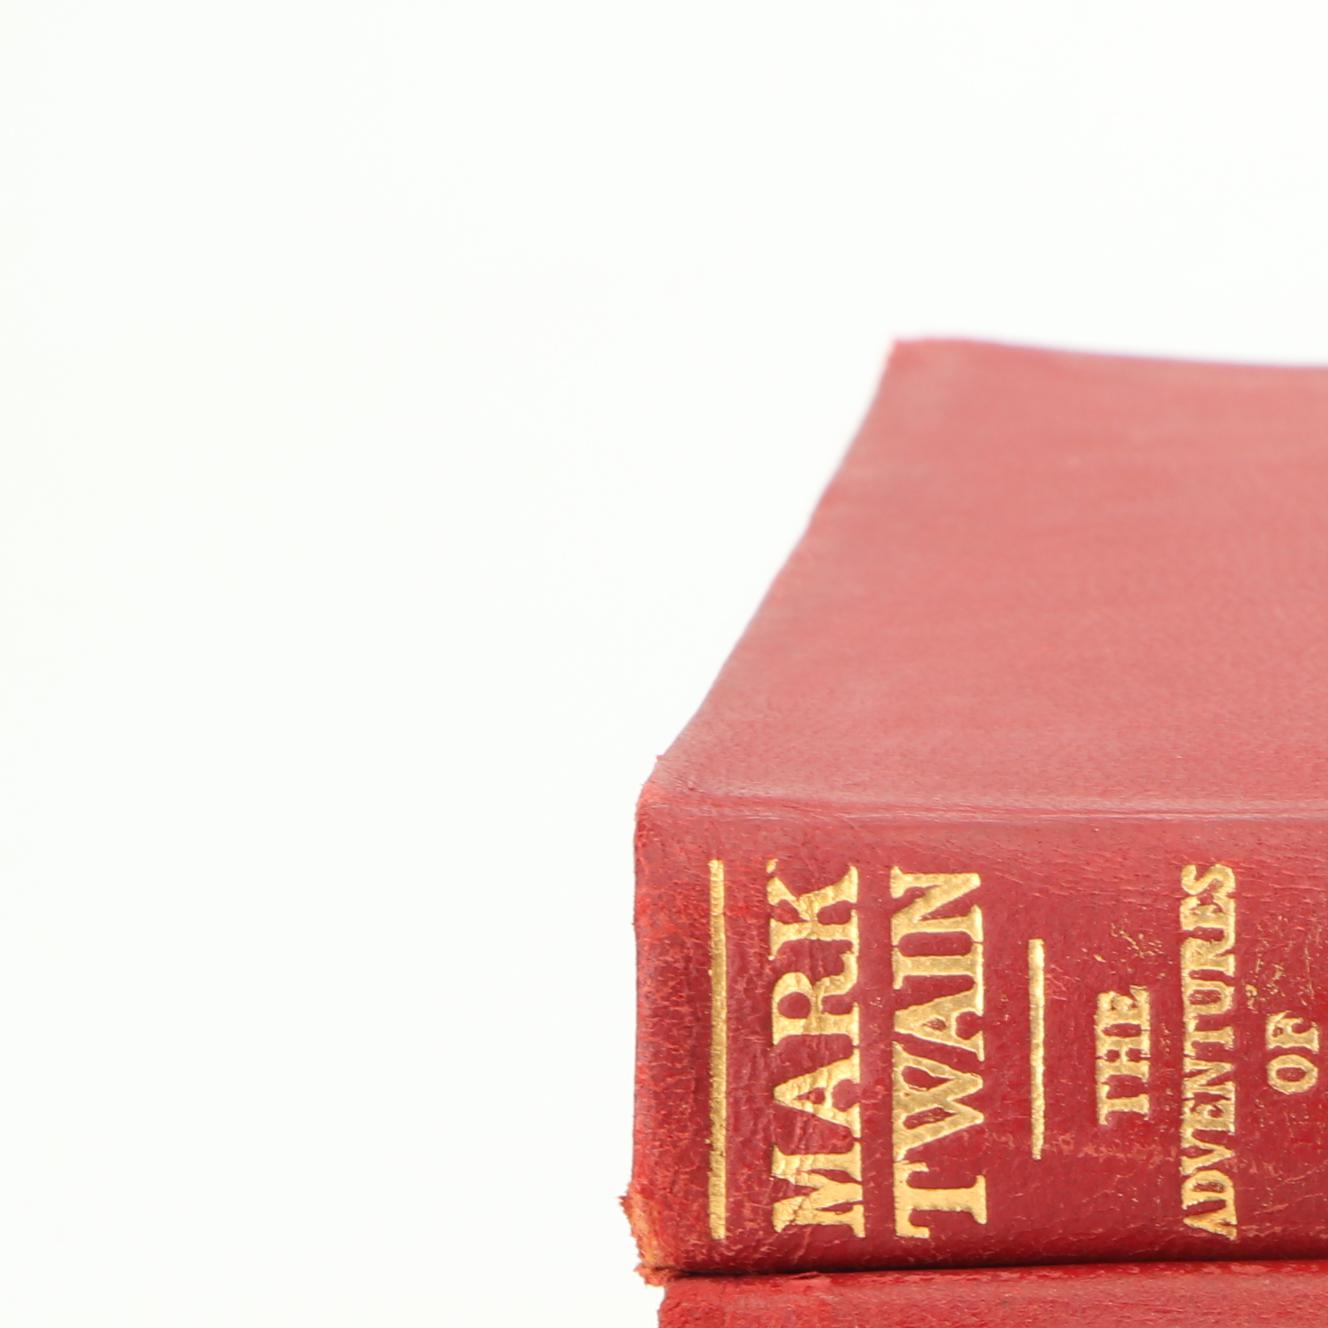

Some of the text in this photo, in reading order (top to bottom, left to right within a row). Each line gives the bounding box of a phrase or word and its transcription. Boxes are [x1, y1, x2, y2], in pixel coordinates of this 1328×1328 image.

[767, 859, 866, 1238] MARK
[891, 865, 987, 1239] TWAIN
[1094, 986, 1151, 1125] THE
[1181, 864, 1238, 1239] ADVENTURES
[1265, 1010, 1319, 1095] OF
